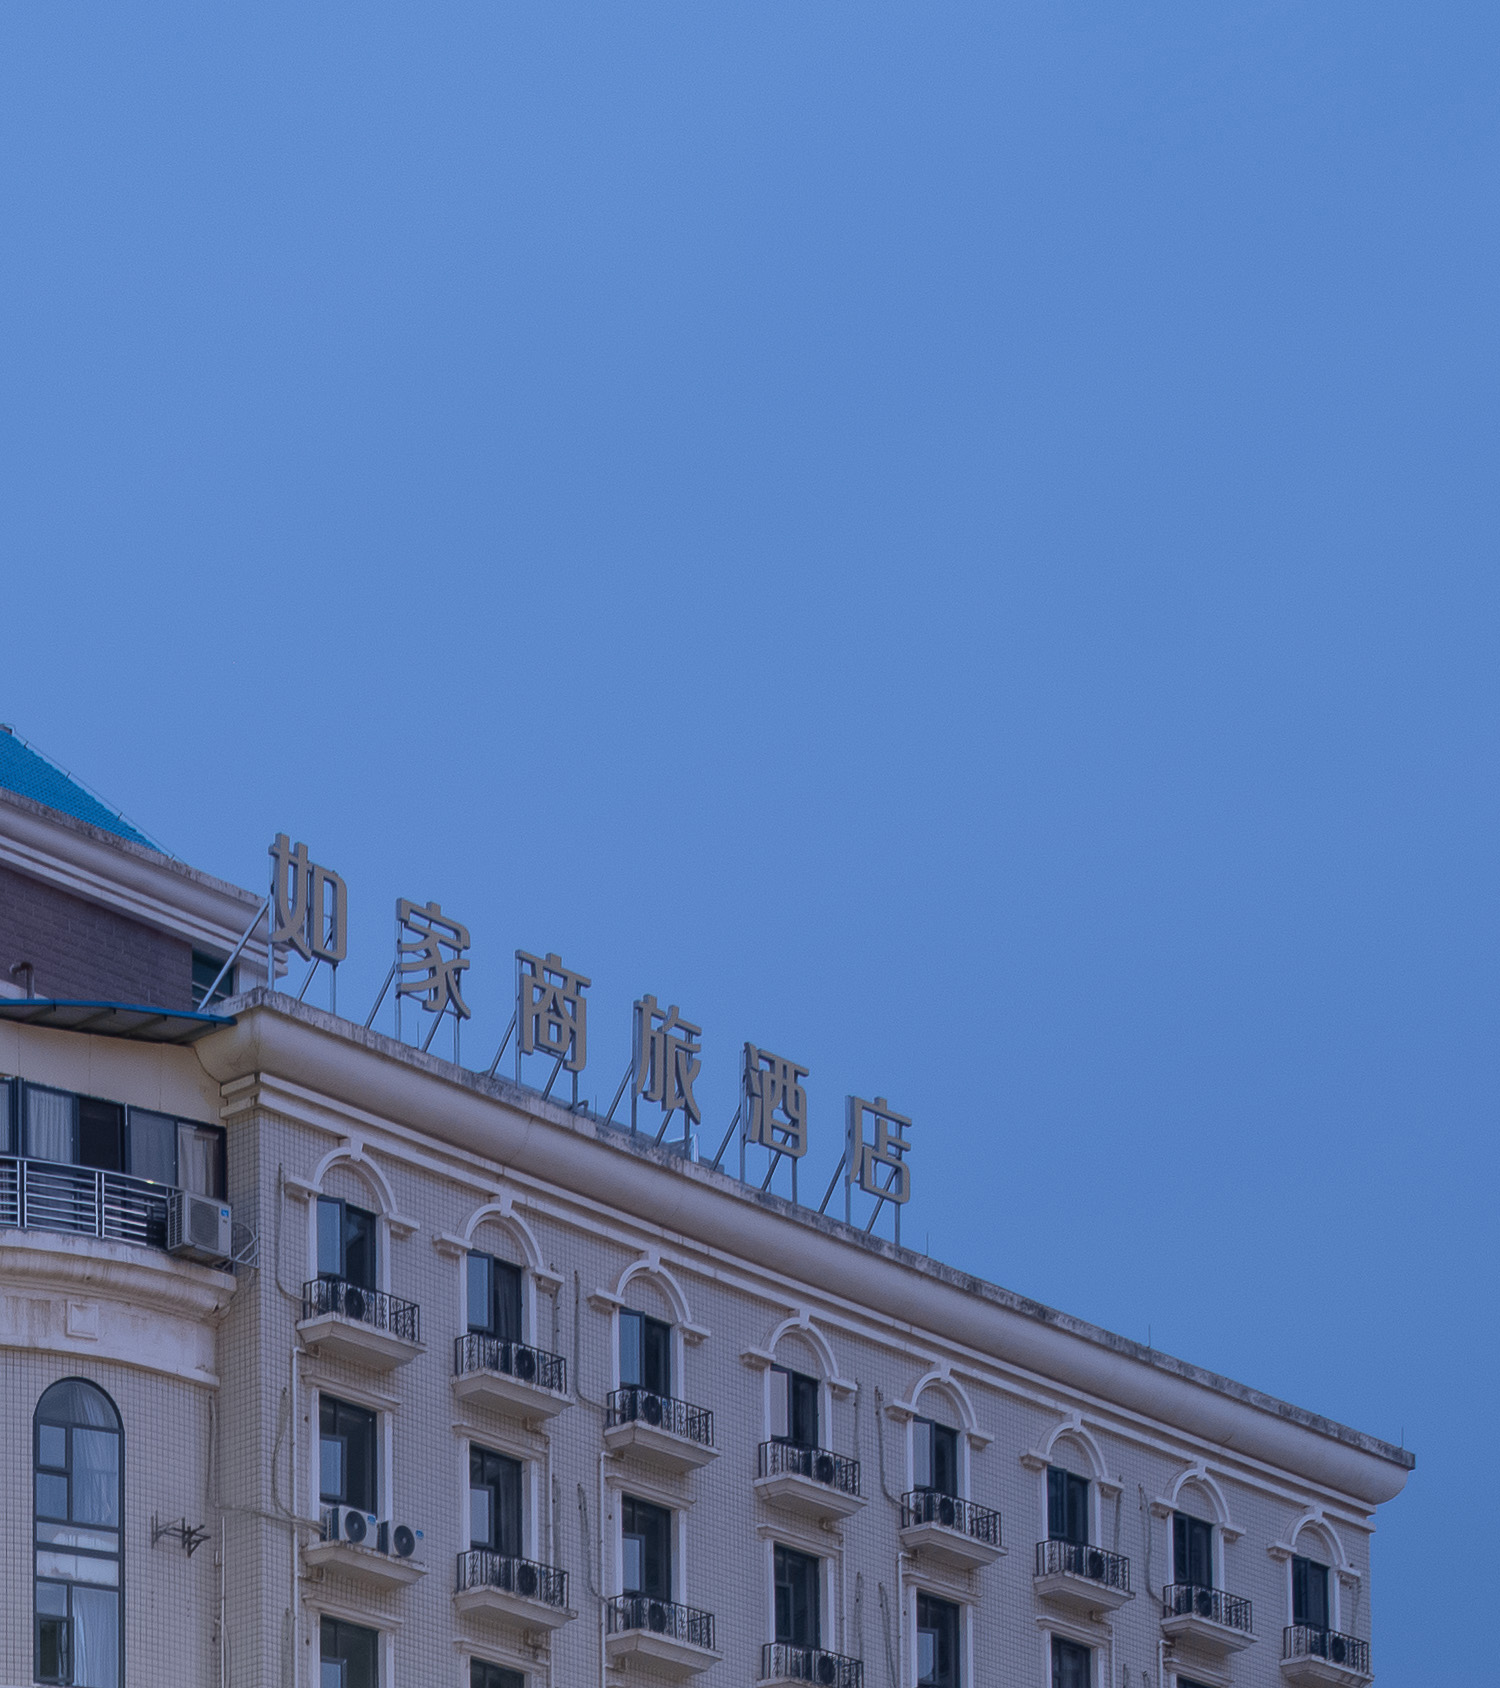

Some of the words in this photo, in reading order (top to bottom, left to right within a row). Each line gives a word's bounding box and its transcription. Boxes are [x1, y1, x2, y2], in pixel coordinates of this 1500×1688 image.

[268, 832, 913, 1205] 如家商旅酒店
